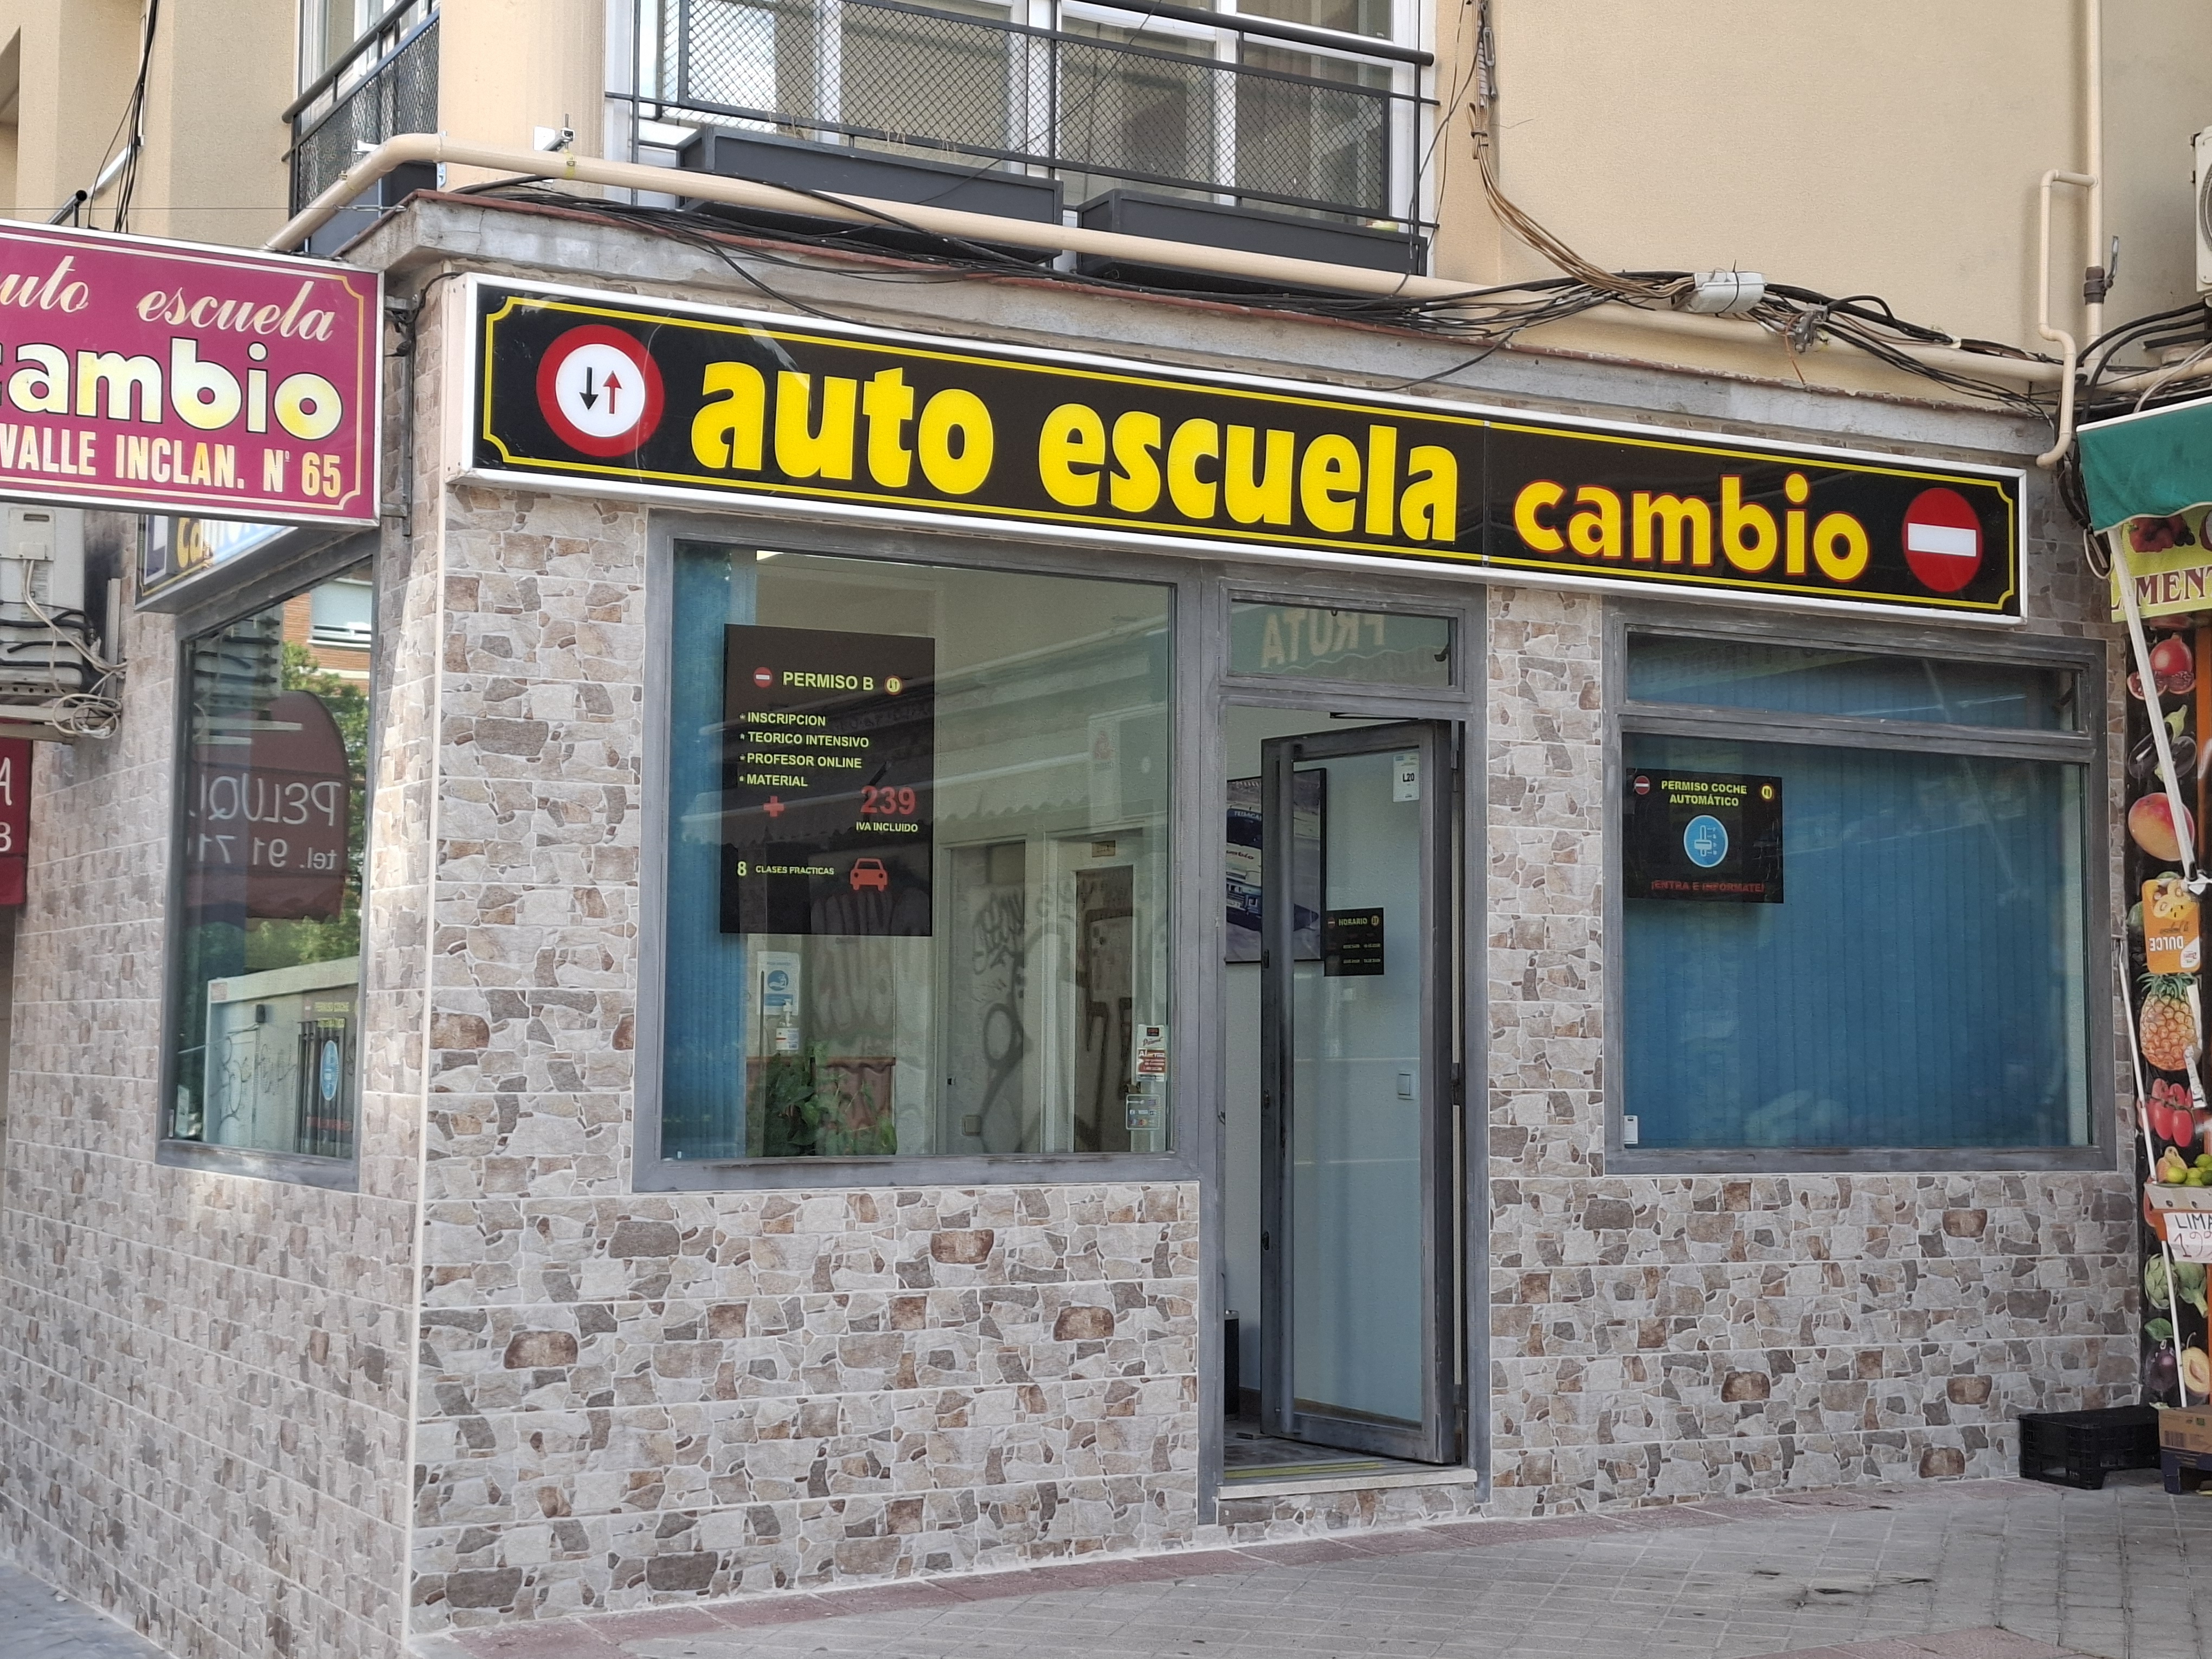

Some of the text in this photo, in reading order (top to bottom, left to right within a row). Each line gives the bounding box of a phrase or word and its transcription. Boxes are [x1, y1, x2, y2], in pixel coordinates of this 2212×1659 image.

[136, 280, 335, 342] escuela
[0, 337, 343, 441] ambio
[0, 423, 97, 477] VALLE
[115, 434, 245, 490] INCLAN.
[301, 451, 341, 498] 65
[691, 361, 1870, 583] auto escuela cambio
[2112, 566, 2212, 612] MEN
[783, 671, 874, 691] PERMISO B
[747, 712, 826, 726] INSCRIPCION
[748, 731, 869, 748] TEORICO INTENSIVO
[747, 753, 863, 768] PROFESOR ONLINE
[747, 774, 808, 787] MATERIAL
[1661, 780, 1747, 794] PERMISO COCHE
[860, 786, 916, 815] 239
[1669, 793, 1739, 807] AUTOMÁTICO
[856, 821, 918, 833] IVA INCLUIDO
[737, 861, 747, 876] 8
[756, 865, 787, 874] CLASES
[2149, 935, 2184, 951] DULCE
